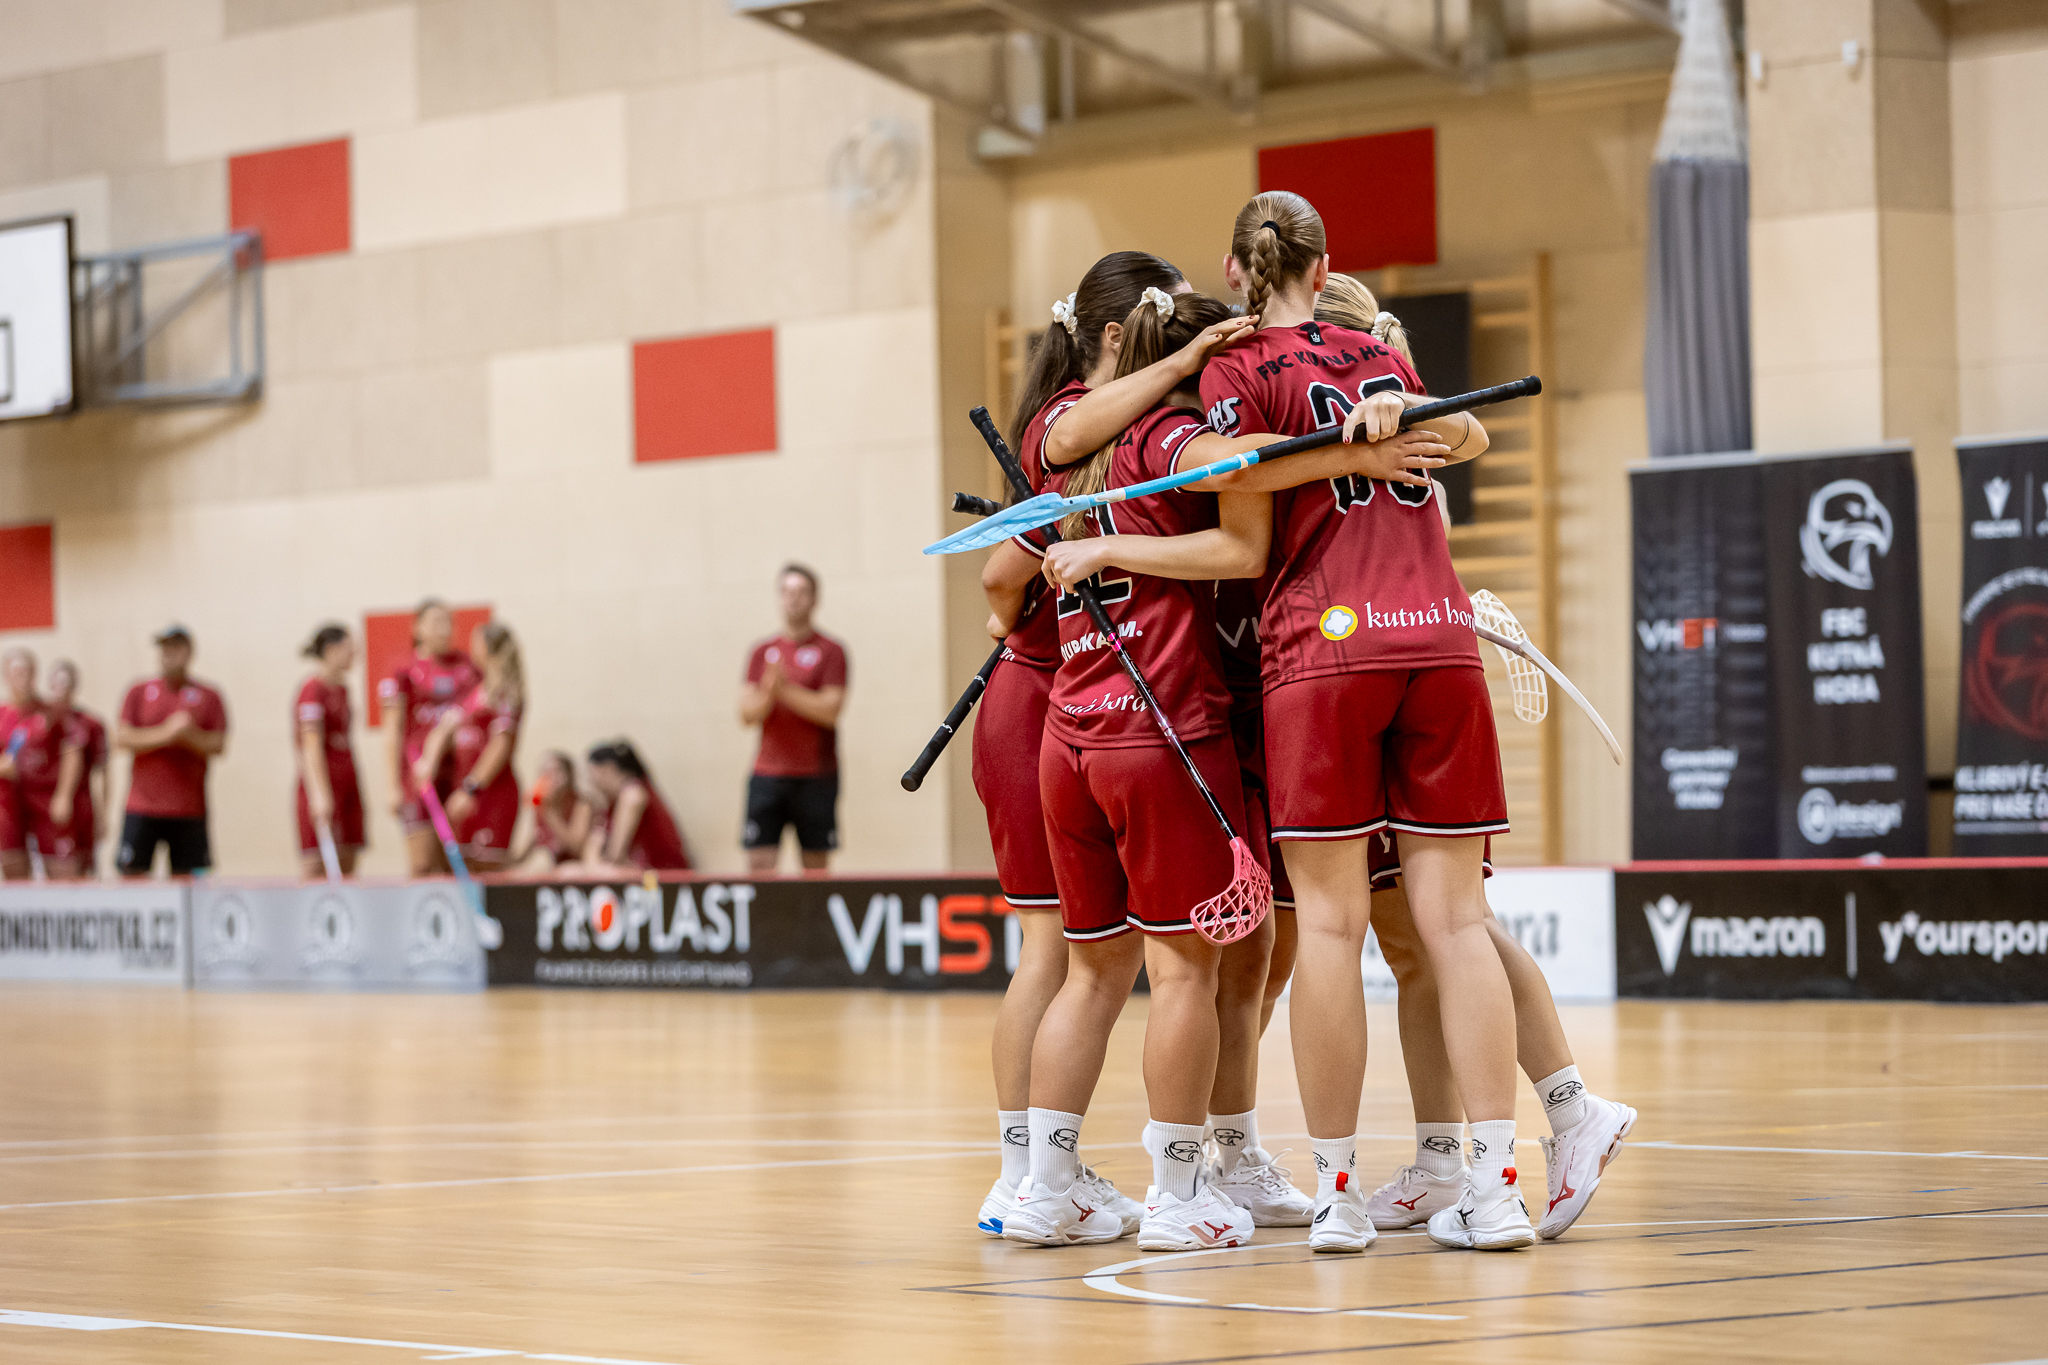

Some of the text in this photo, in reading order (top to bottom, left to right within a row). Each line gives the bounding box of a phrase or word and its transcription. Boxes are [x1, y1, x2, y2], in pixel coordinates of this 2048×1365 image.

[1256, 354, 1294, 382] FBC
[1364, 600, 1443, 629] kutná
[1820, 606, 1868, 638] FBC
[1807, 634, 1886, 671] KUTNÁ
[535, 884, 757, 953] PROPLAST
[1690, 916, 1826, 958] macron
